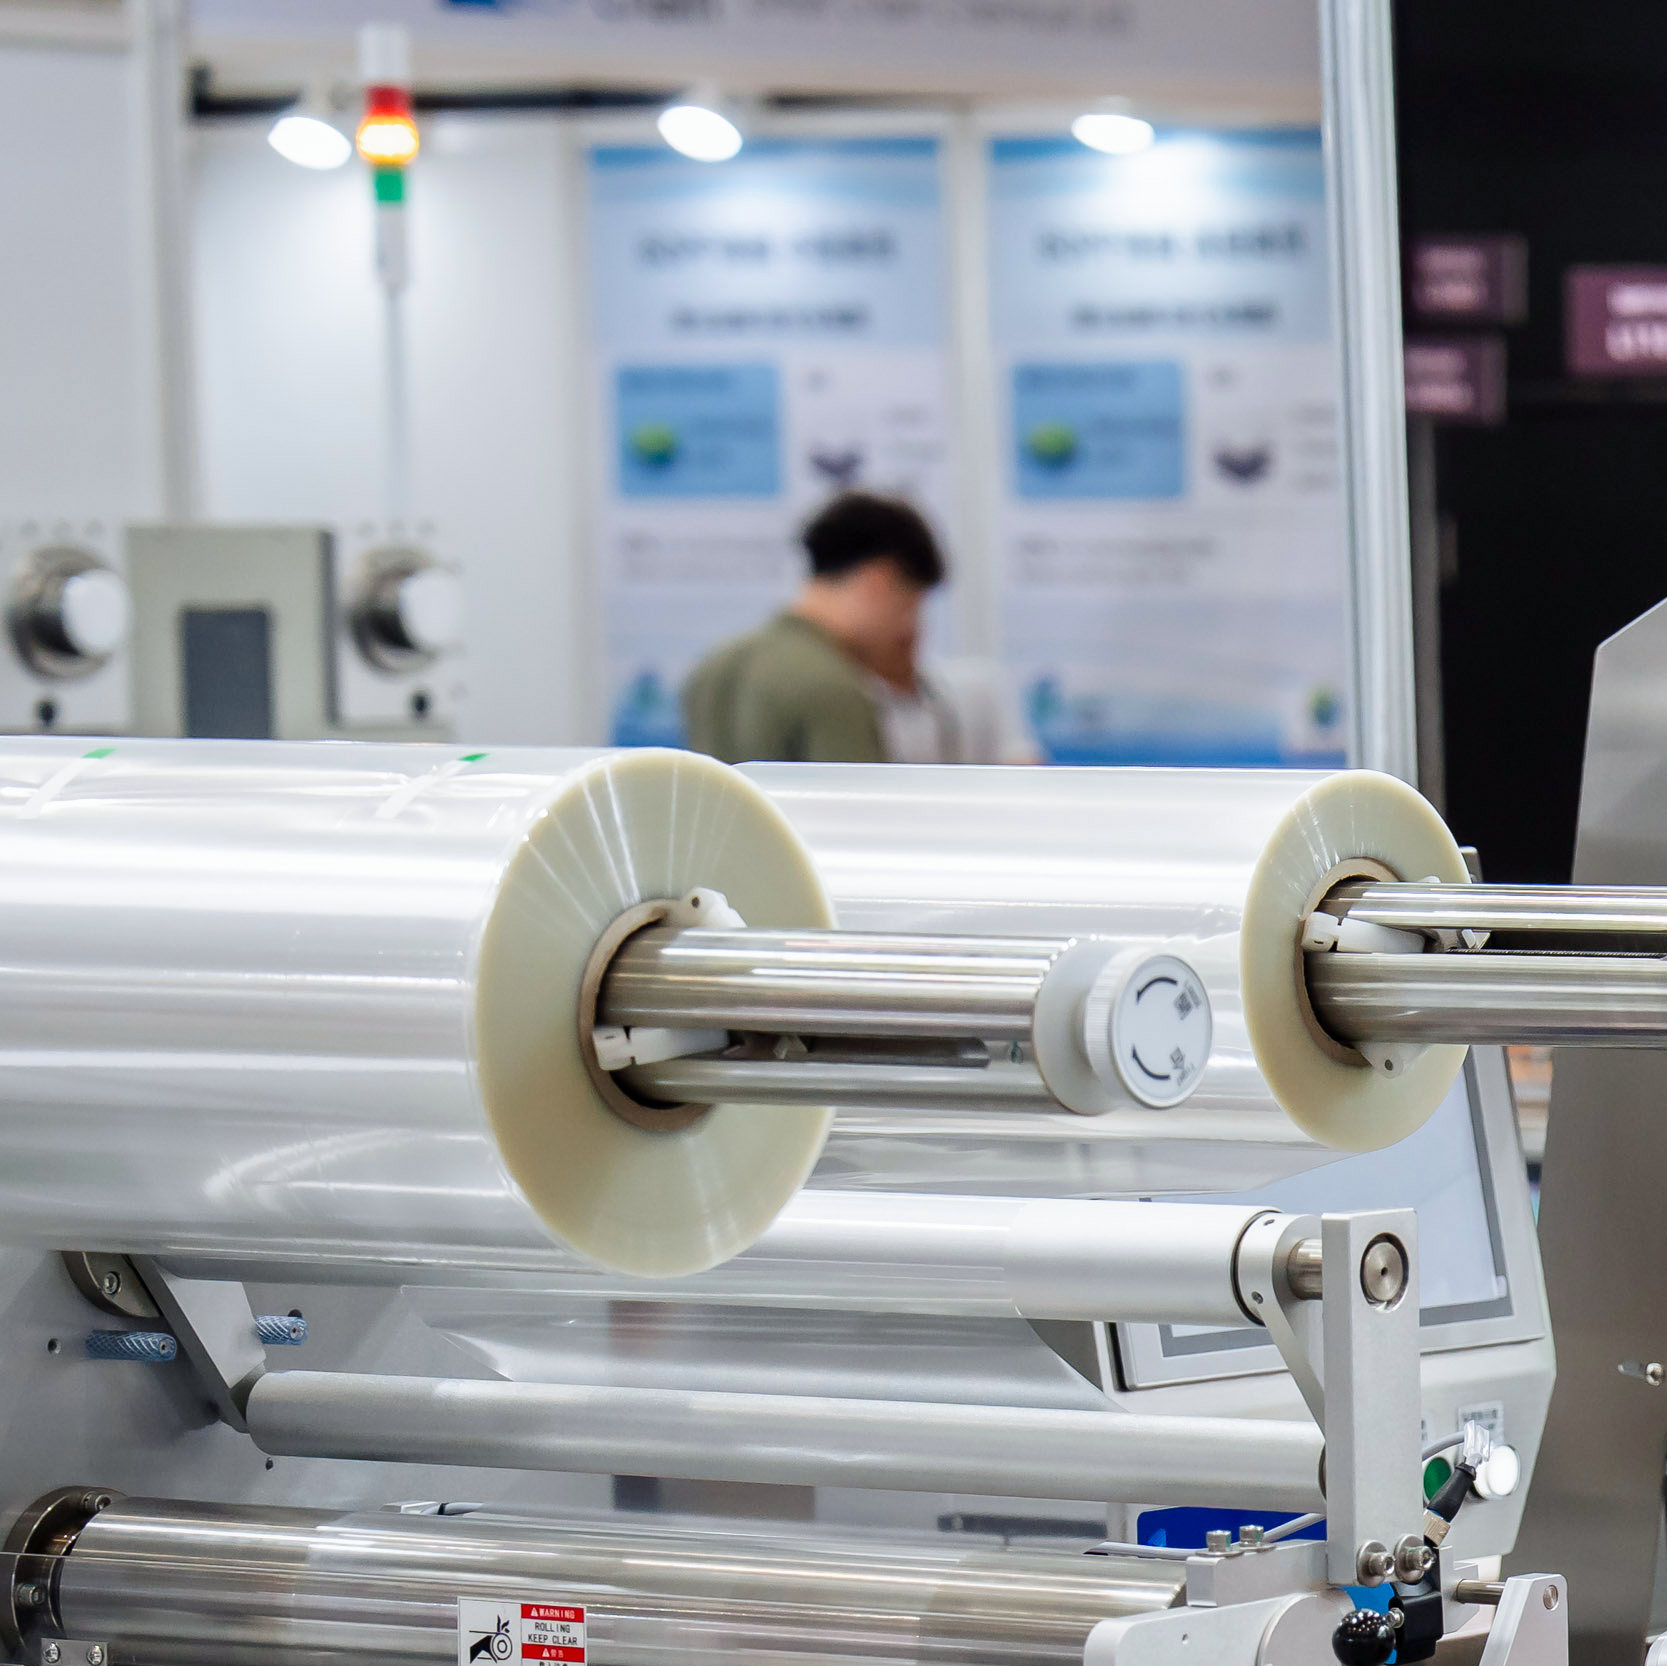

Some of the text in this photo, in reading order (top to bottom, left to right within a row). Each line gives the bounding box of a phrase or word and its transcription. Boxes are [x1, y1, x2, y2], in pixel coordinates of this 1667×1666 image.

[539, 1608, 575, 1619] WARNING
[534, 1622, 571, 1633] ROLLING
[528, 1634, 578, 1645] KEEP CLEAR
